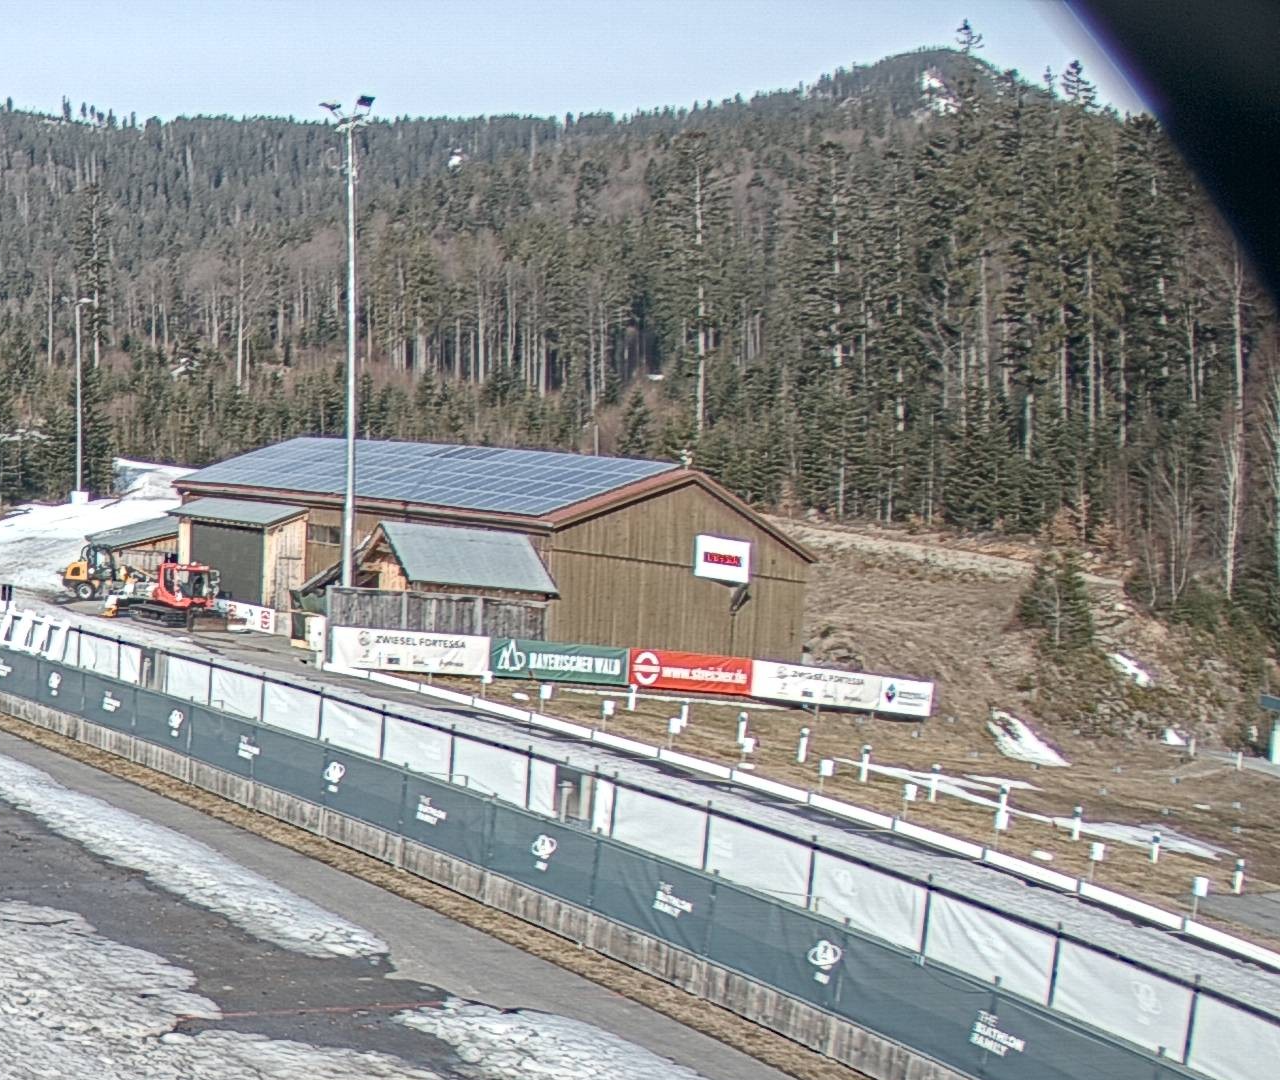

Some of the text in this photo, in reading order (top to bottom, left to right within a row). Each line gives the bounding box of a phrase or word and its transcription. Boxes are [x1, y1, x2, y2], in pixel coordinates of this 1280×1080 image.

[374, 635, 466, 649] ZWIESEL FORTESSA
[594, 657, 621, 676] WALD
